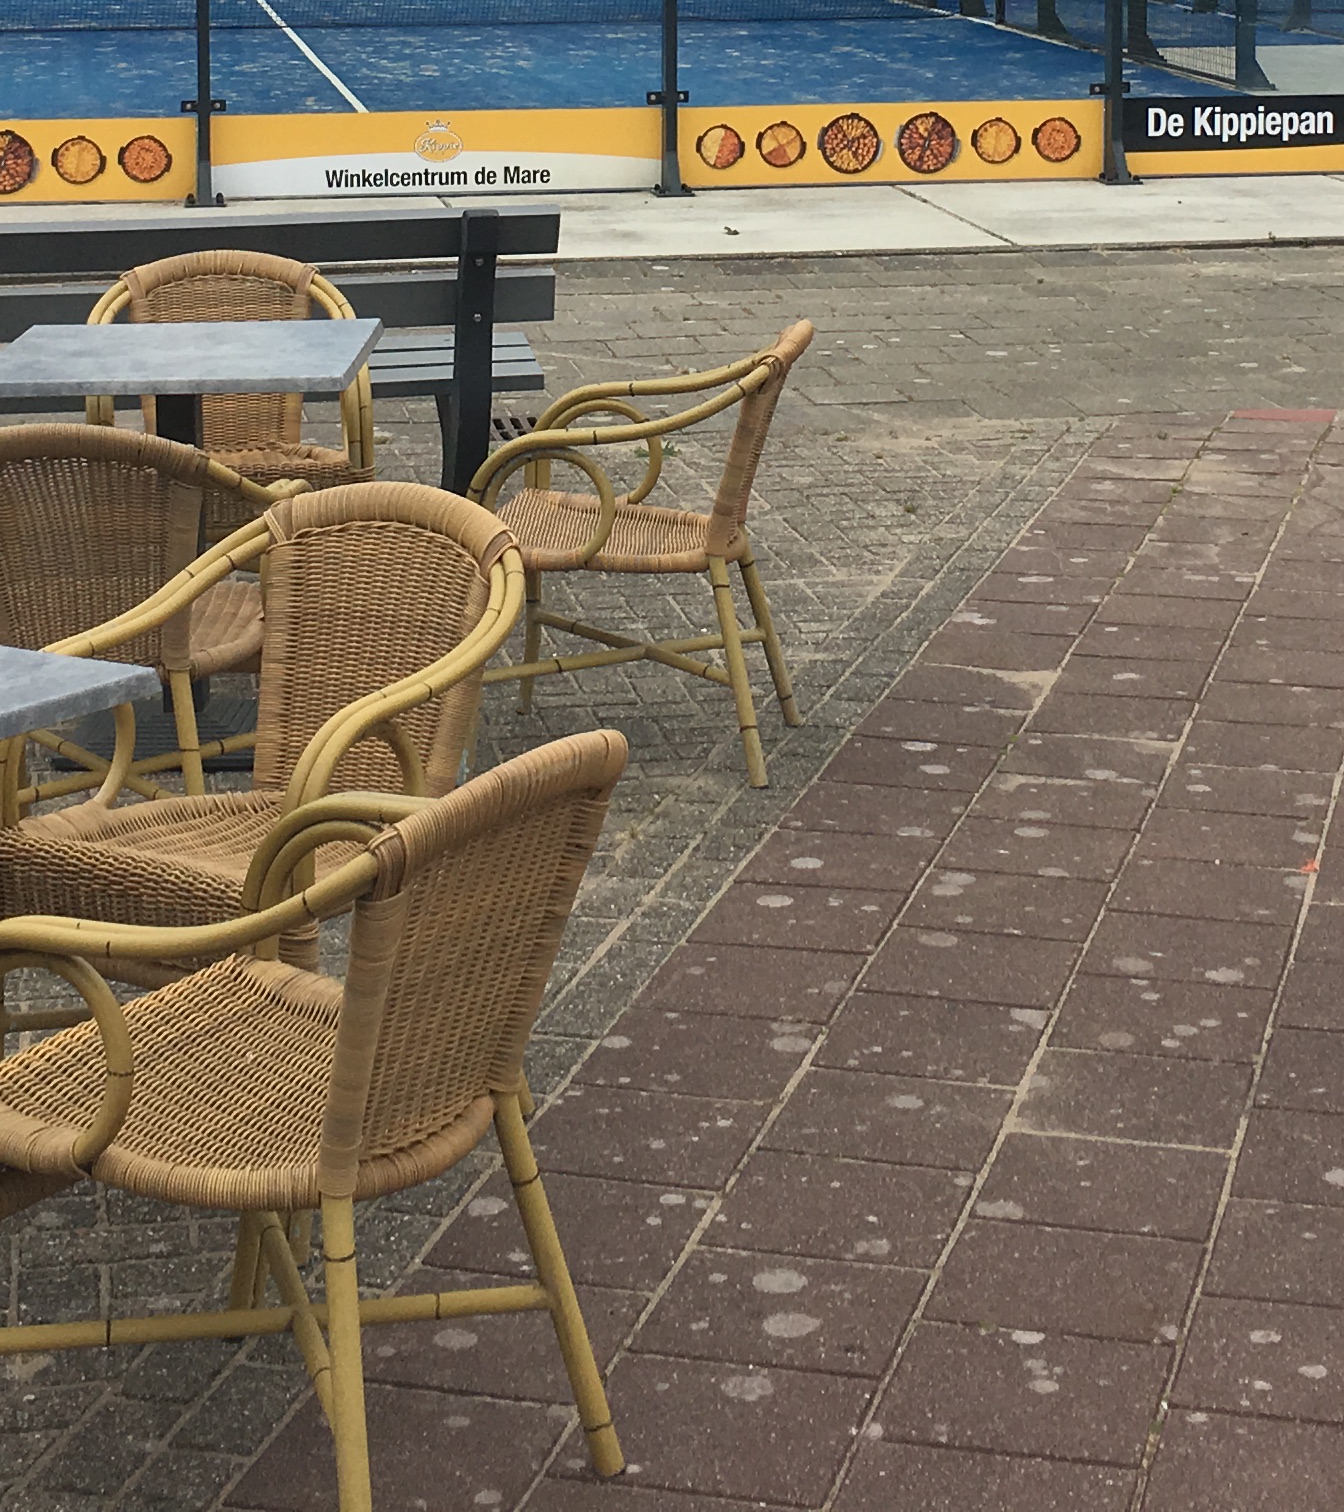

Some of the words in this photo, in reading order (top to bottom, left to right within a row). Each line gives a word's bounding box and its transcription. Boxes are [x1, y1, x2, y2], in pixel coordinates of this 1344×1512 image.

[1147, 107, 1184, 137] De
[1194, 105, 1334, 142] Kippiepan
[325, 168, 468, 188] Winkelcentrum
[474, 167, 497, 185] de
[504, 166, 550, 184] Mare
